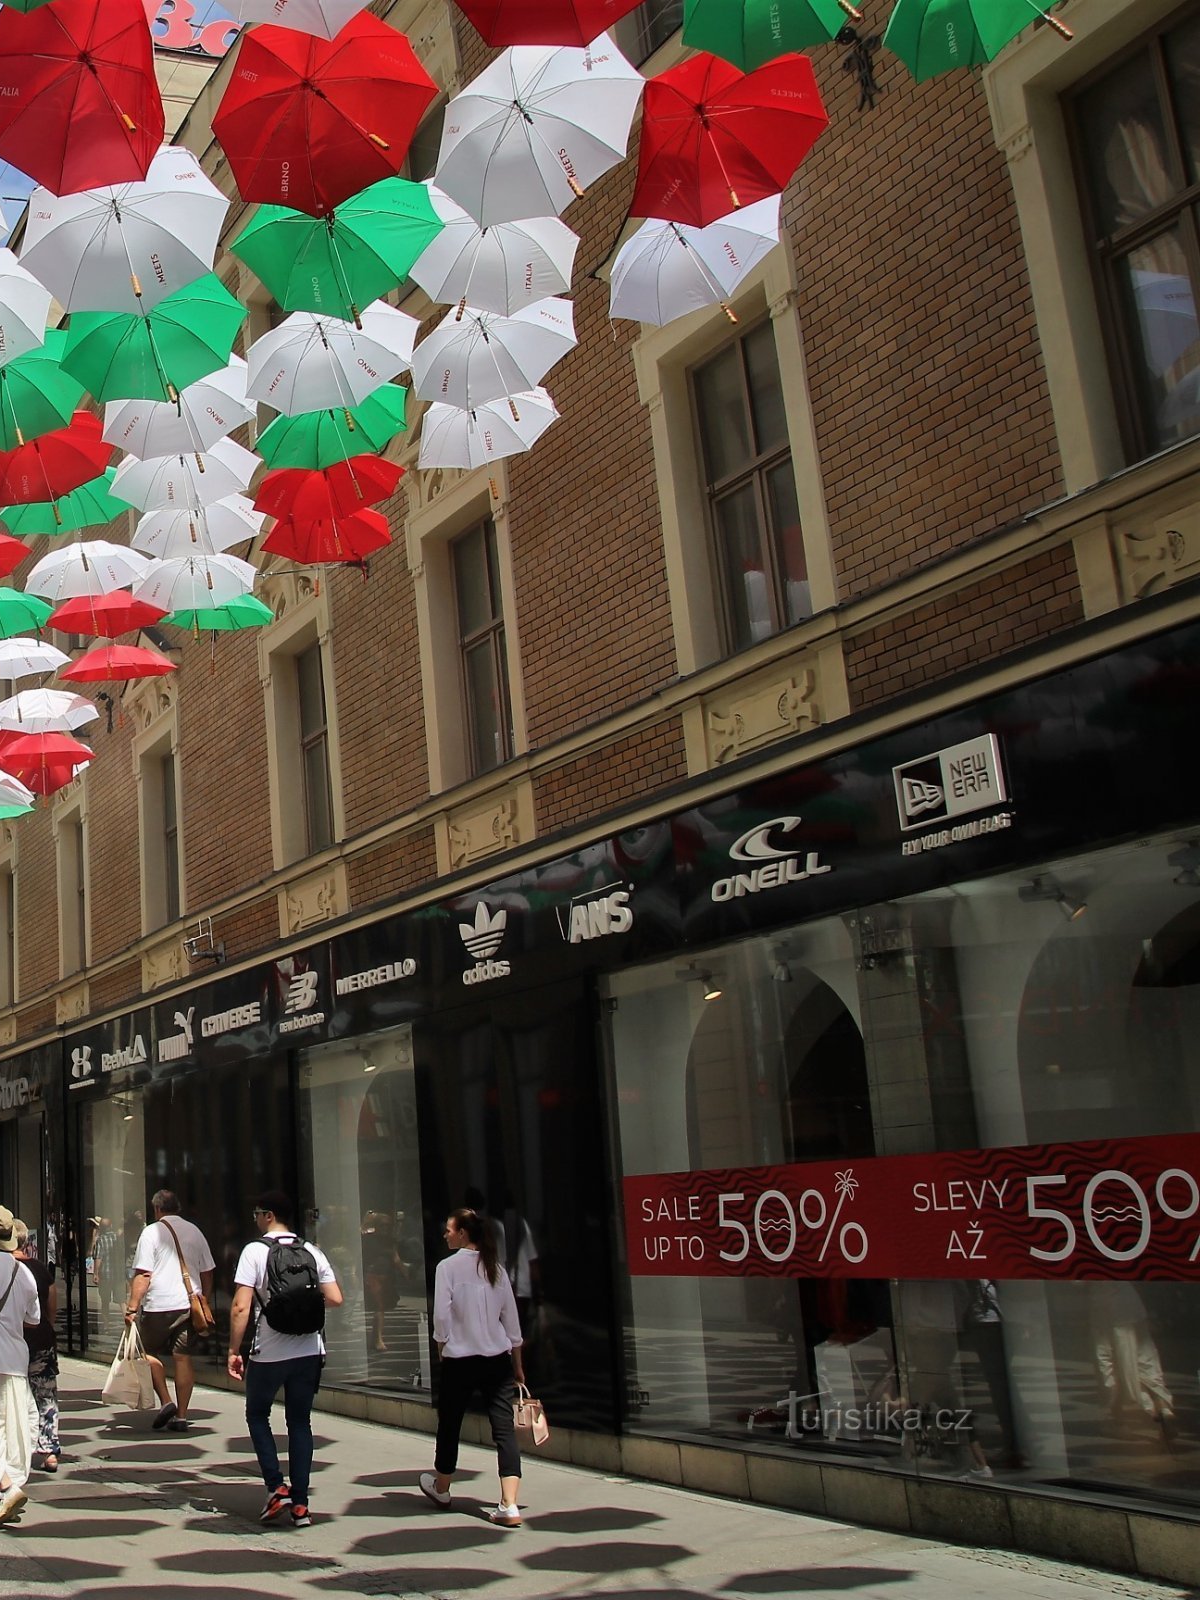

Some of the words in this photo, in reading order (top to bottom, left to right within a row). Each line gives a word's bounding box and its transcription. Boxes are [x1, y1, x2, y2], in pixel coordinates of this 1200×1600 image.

[771, 4, 783, 40] MEETS
[946, 22, 959, 55] BRNO
[769, 88, 803, 99] MEETS
[281, 161, 290, 192] BRNO
[557, 148, 577, 179] MEETS
[723, 242, 740, 267] ITALIA
[150, 253, 166, 284] MEETS
[525, 262, 533, 290] ITALIA
[311, 277, 321, 303] BRNO
[539, 310, 564, 325] ITALIA
[269, 368, 285, 393] MEETS
[357, 358, 378, 378] BRNO
[441, 369, 451, 394] BRNO
[124, 415, 140, 437] MEETS
[205, 406, 226, 425] BRNO
[949, 752, 987, 779] NEW
[952, 771, 990, 798] ERA
[902, 838, 922, 855] FLY
[920, 830, 949, 850] YOUR
[951, 821, 977, 841] OWN
[979, 812, 1011, 834] FLAG
[336, 961, 407, 996] MERRELL
[462, 959, 511, 986] adidas
[201, 1002, 261, 1038] CONVERSE
[912, 1178, 1010, 1212] SLEVY
[641, 1196, 702, 1222] SALE
[717, 1184, 869, 1263] 50%
[643, 1236, 672, 1261] UP
[673, 1236, 705, 1261] TO
[945, 1221, 988, 1260] AŽ
